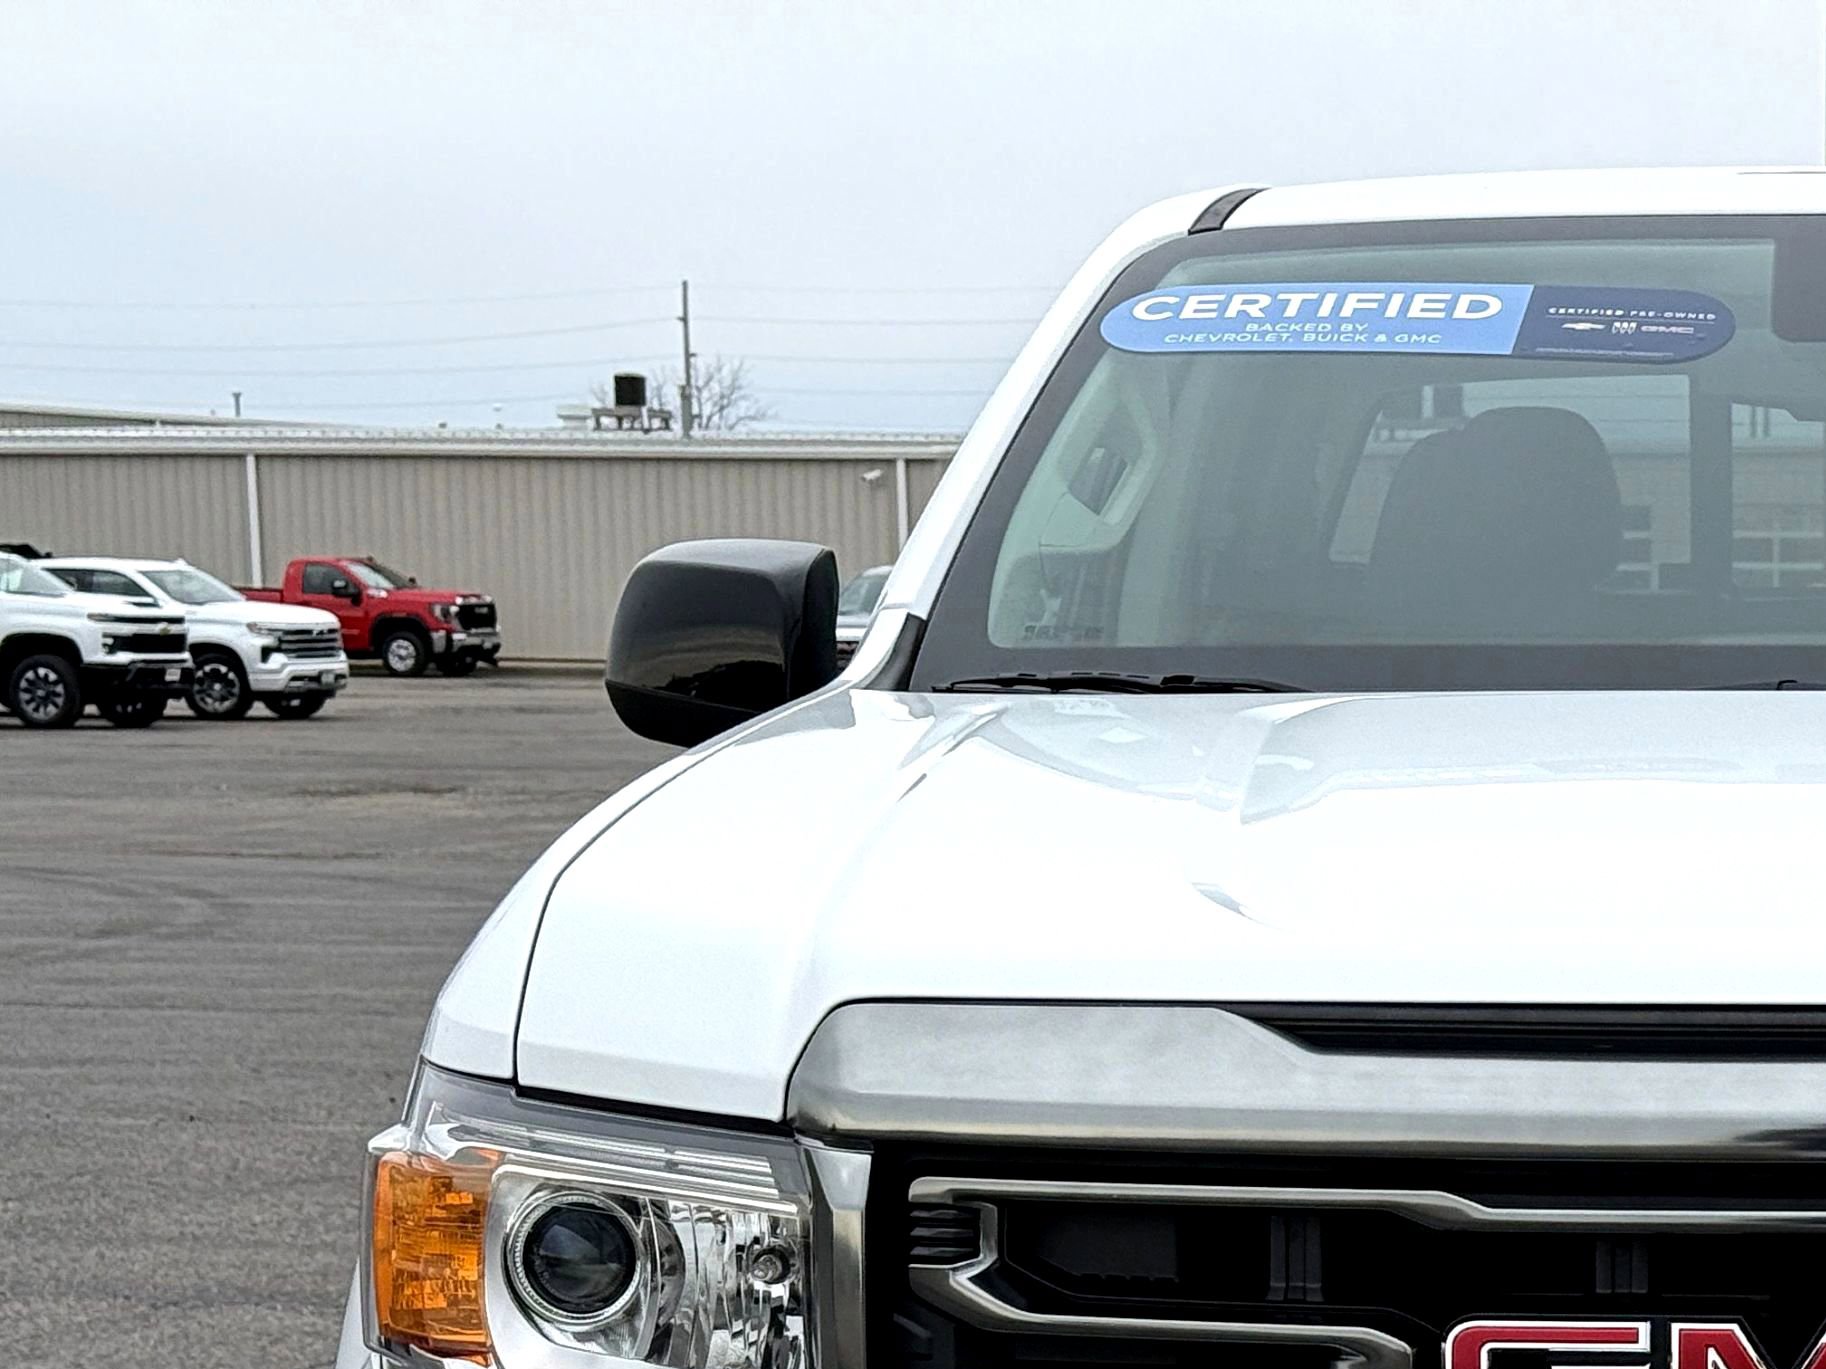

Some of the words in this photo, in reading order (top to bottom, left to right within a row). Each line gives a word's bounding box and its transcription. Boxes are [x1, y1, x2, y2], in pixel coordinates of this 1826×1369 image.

[1132, 292, 1503, 321] CERTIFIED
[1548, 307, 1625, 316] CERTIFIED
[1630, 311, 1717, 320] PRE-OWNED
[1245, 323, 1332, 332] BACKED
[1340, 323, 1369, 332] BY
[1640, 325, 1695, 334] GMC
[1303, 333, 1369, 342] BUICK
[1374, 333, 1387, 343] &
[1394, 334, 1443, 344] GMC
